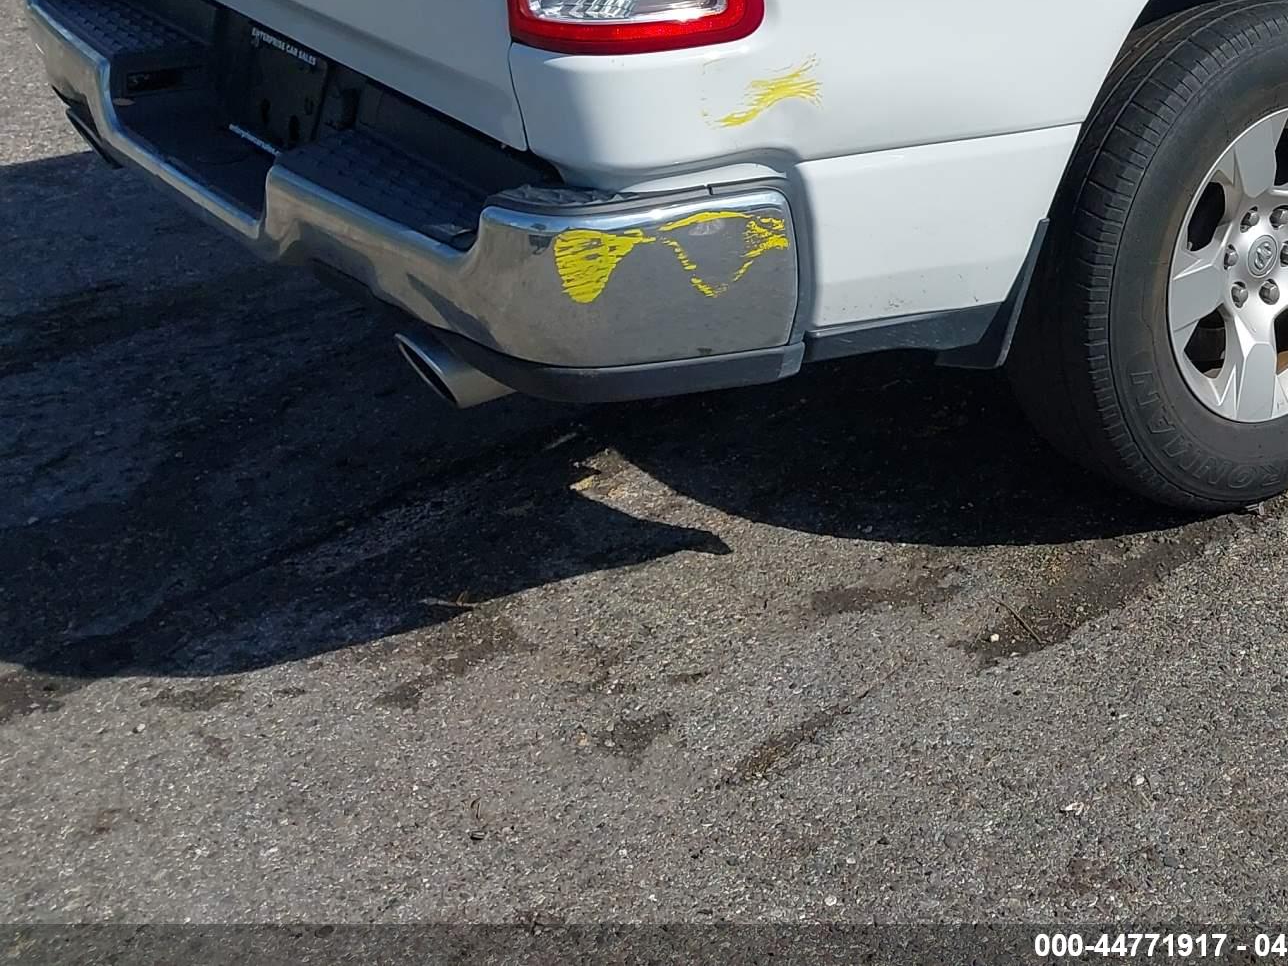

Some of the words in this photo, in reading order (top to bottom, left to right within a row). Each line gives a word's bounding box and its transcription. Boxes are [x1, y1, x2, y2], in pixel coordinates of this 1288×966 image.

[251, 27, 286, 51] ENTERPRISE
[286, 44, 299, 57] CAR
[298, 50, 317, 66] SALES
